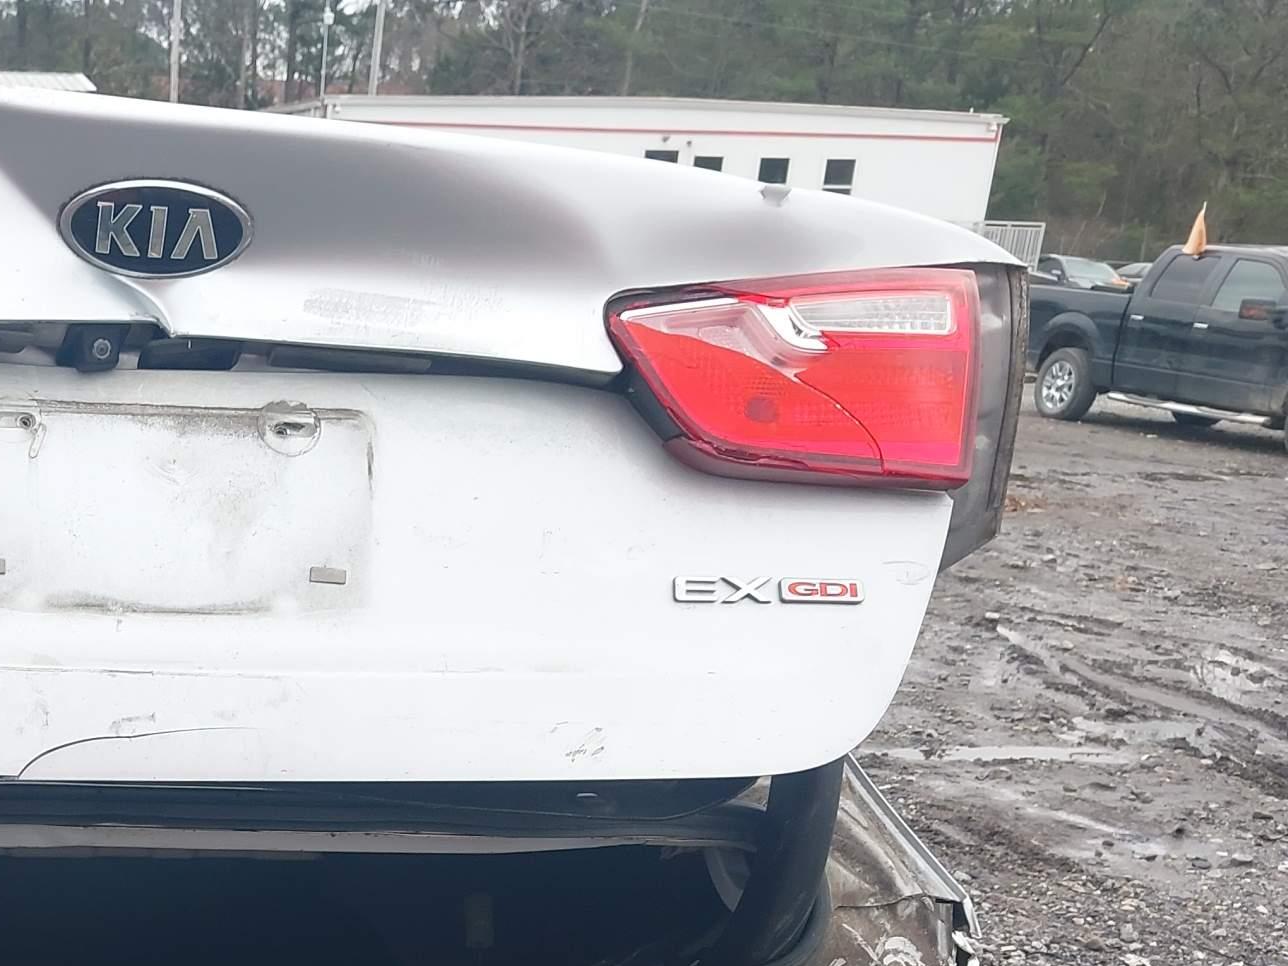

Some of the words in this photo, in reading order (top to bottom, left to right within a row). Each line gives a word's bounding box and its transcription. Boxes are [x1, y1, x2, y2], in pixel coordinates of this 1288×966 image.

[95, 201, 218, 260] KIA
[673, 576, 772, 604] EX
[787, 582, 858, 598] GDI
